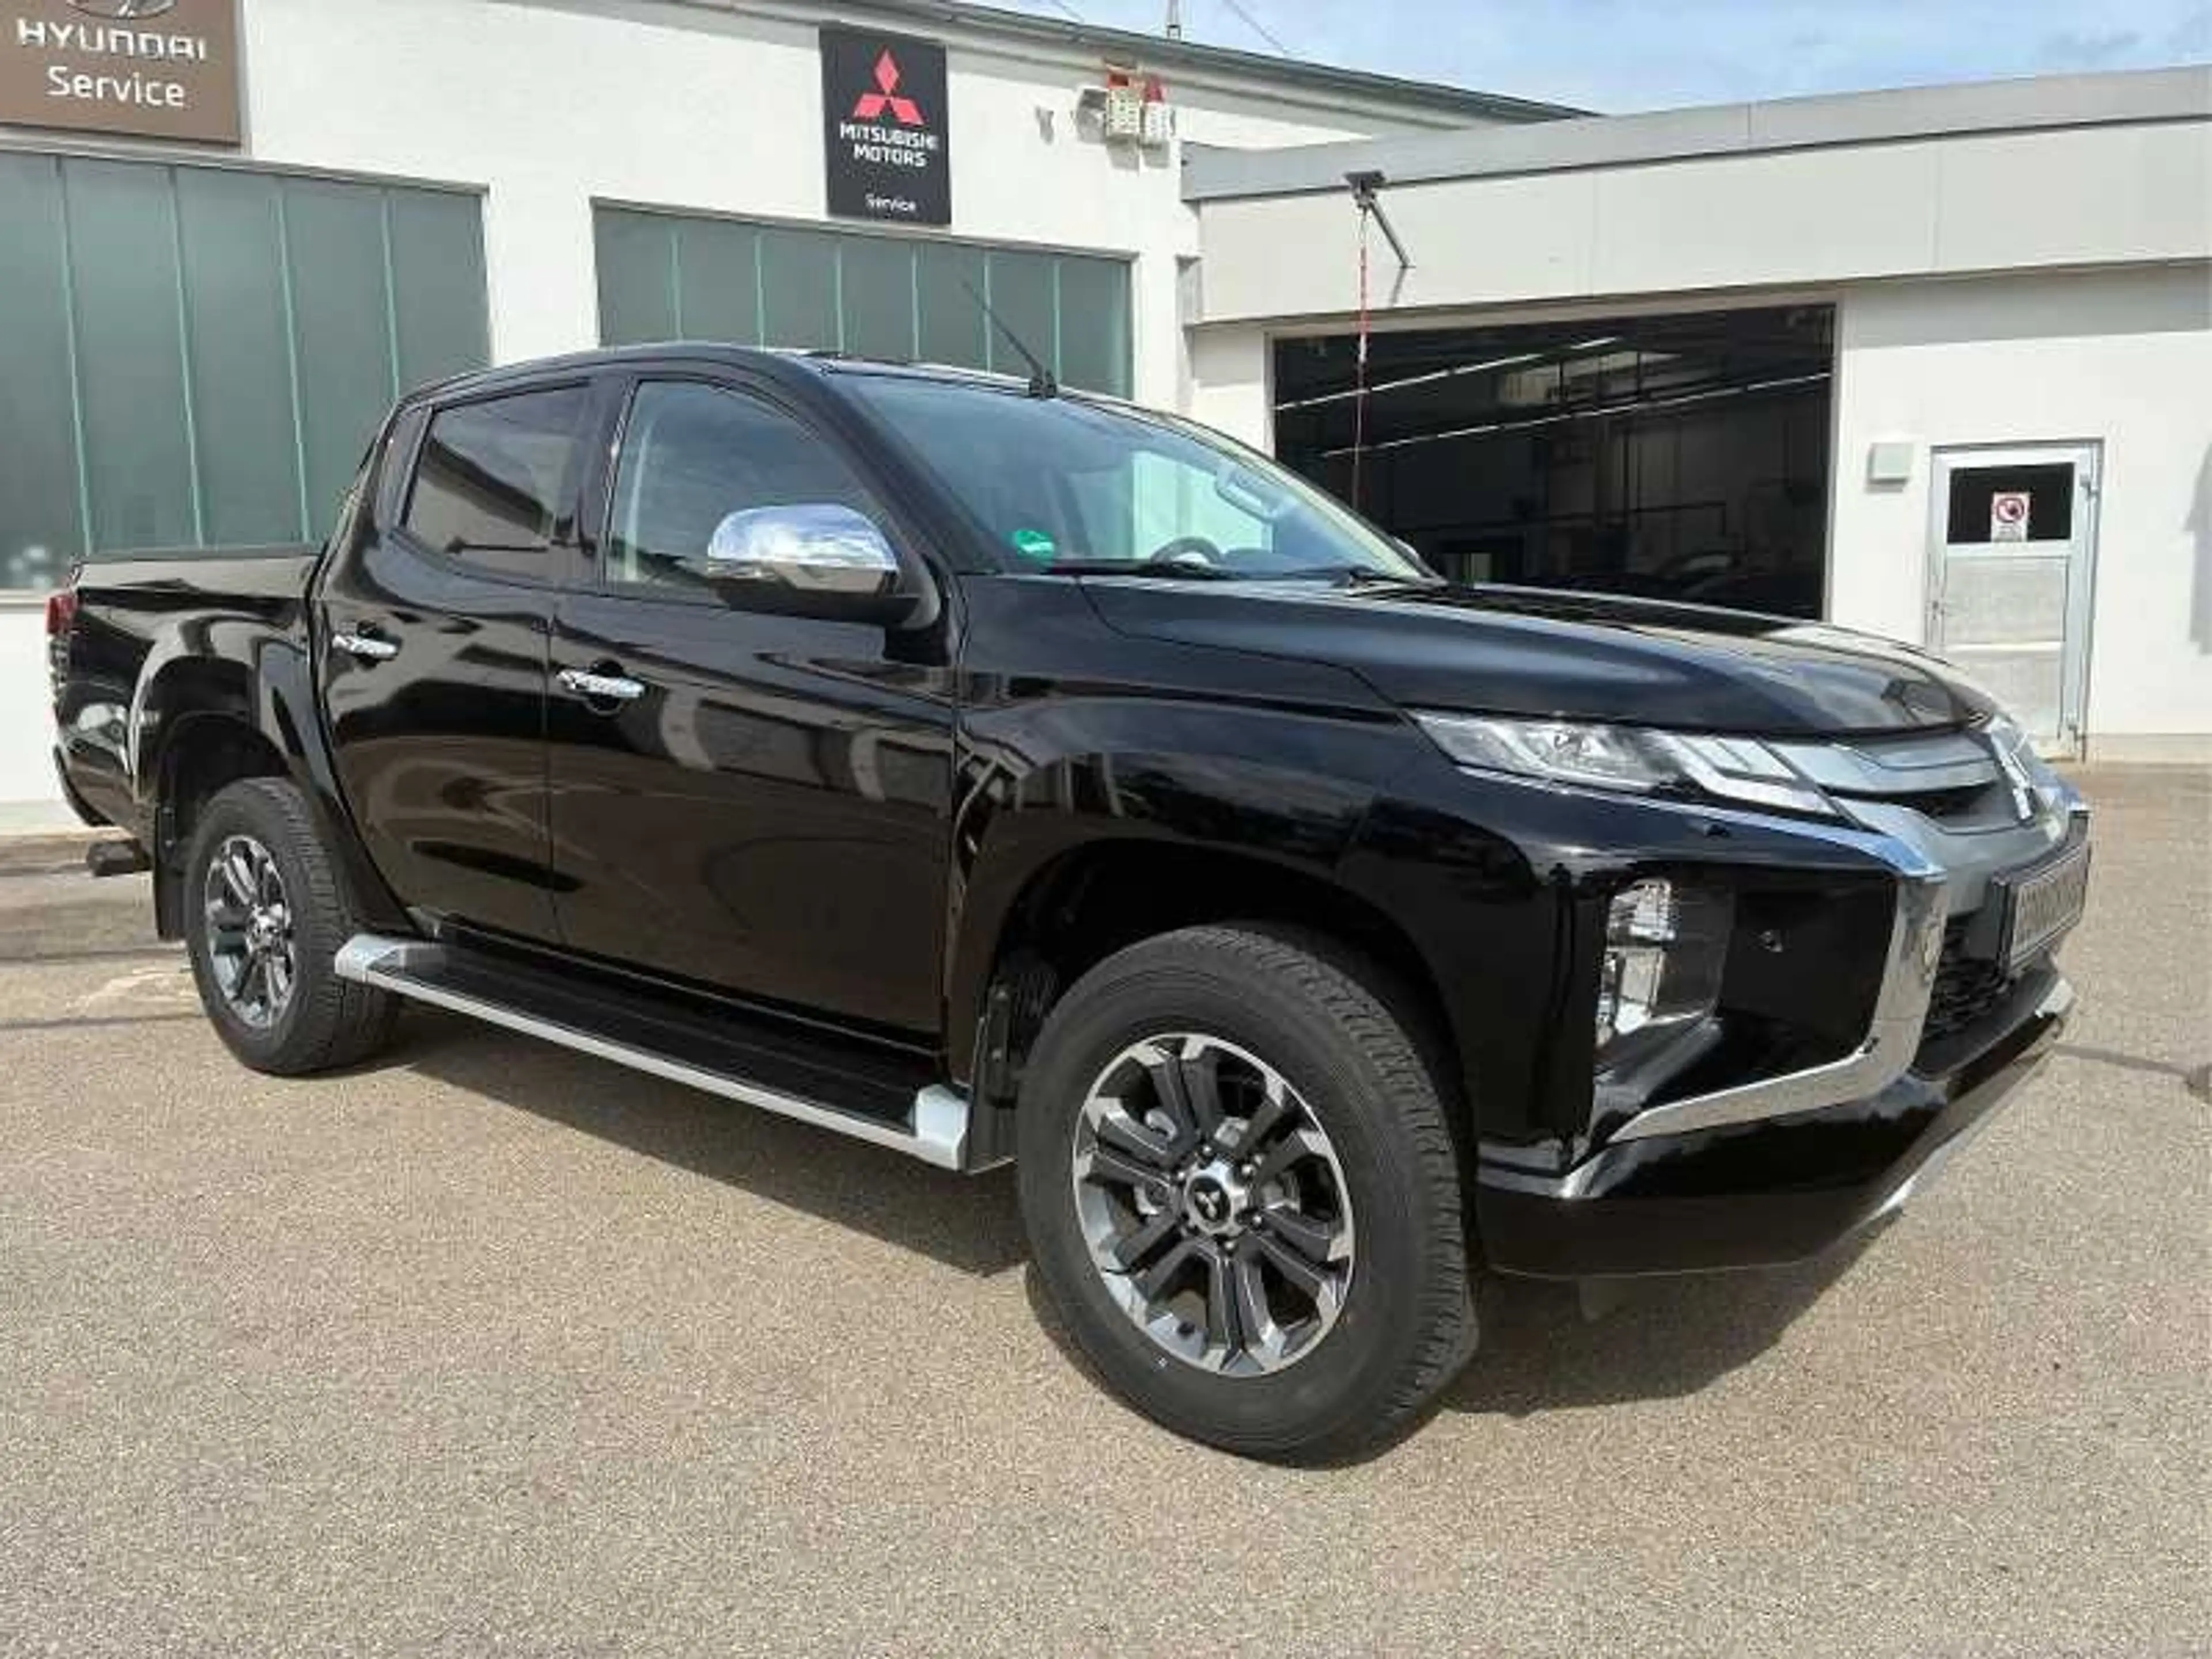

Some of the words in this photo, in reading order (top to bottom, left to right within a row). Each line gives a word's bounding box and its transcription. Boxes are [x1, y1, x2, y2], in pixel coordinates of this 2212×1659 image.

[17, 18, 207, 59] HYUNDAI
[47, 65, 185, 107] Service
[839, 122, 939, 150] MITSUBISHI
[853, 143, 927, 168] MOTORS
[865, 194, 916, 213] Service
